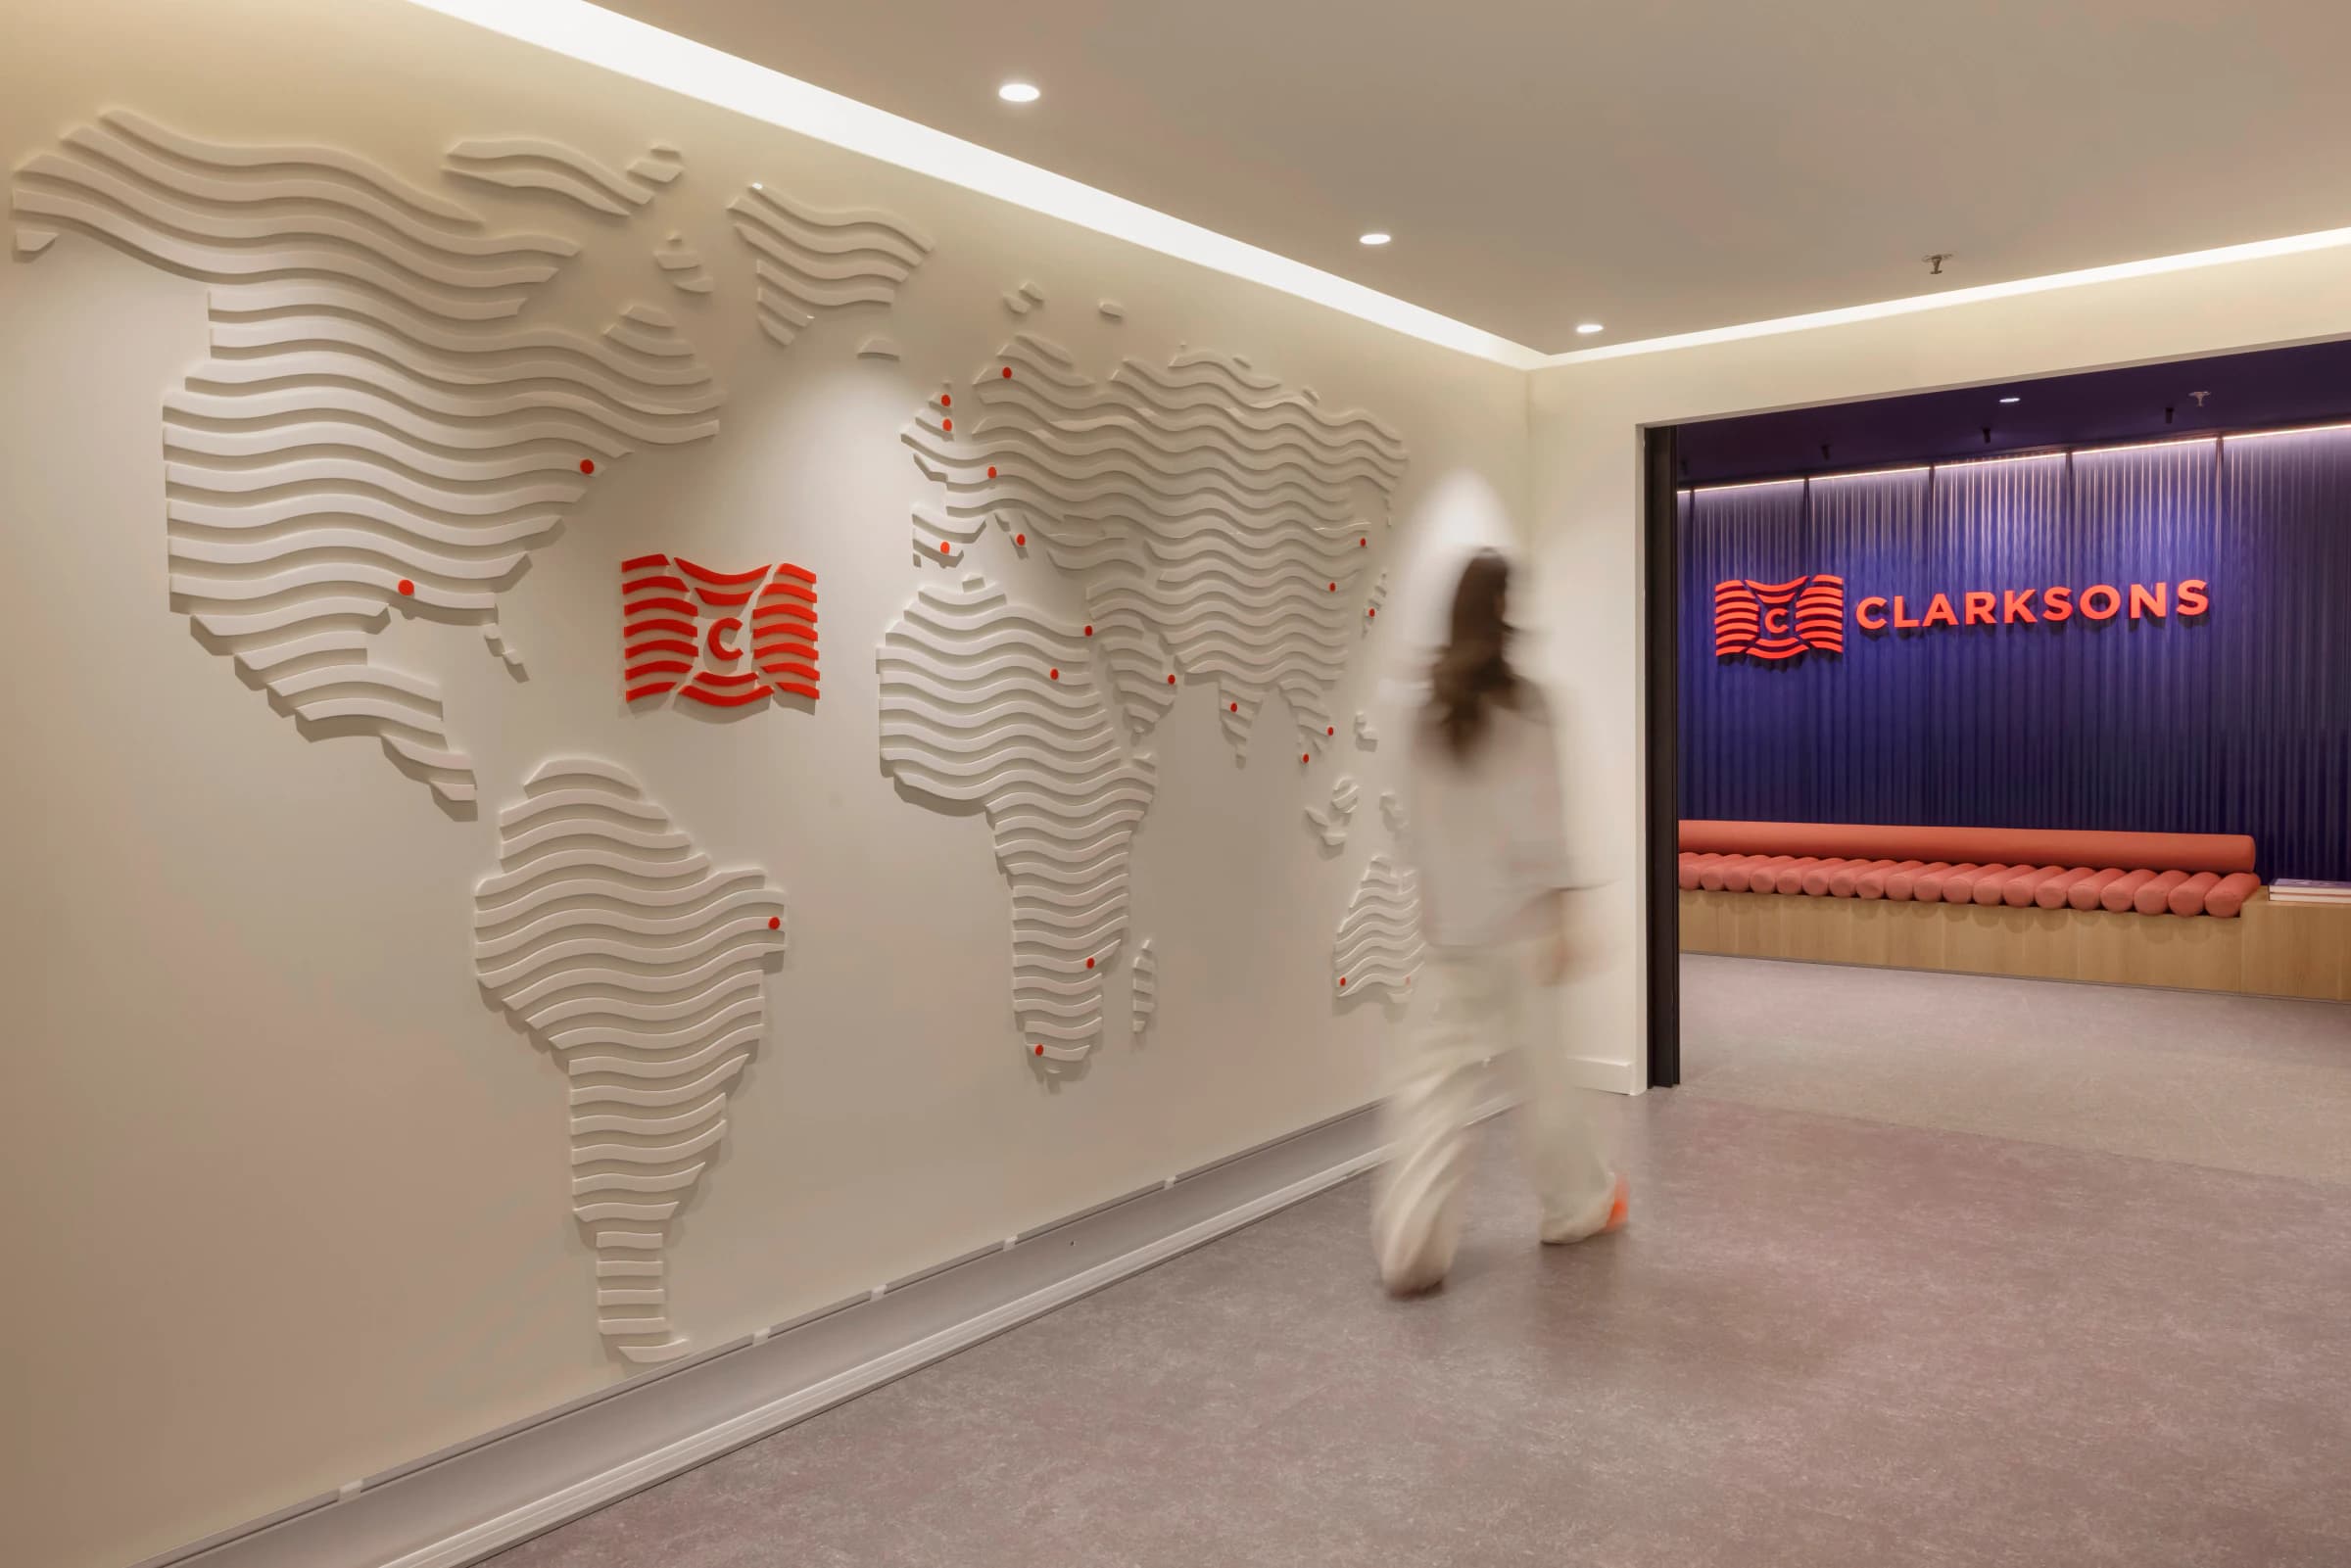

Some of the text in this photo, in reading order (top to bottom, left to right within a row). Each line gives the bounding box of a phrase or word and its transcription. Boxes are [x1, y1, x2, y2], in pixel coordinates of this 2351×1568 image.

[1765, 607, 1790, 634] C
[1855, 579, 2210, 630] CLARKSONS
[707, 617, 744, 661] C
